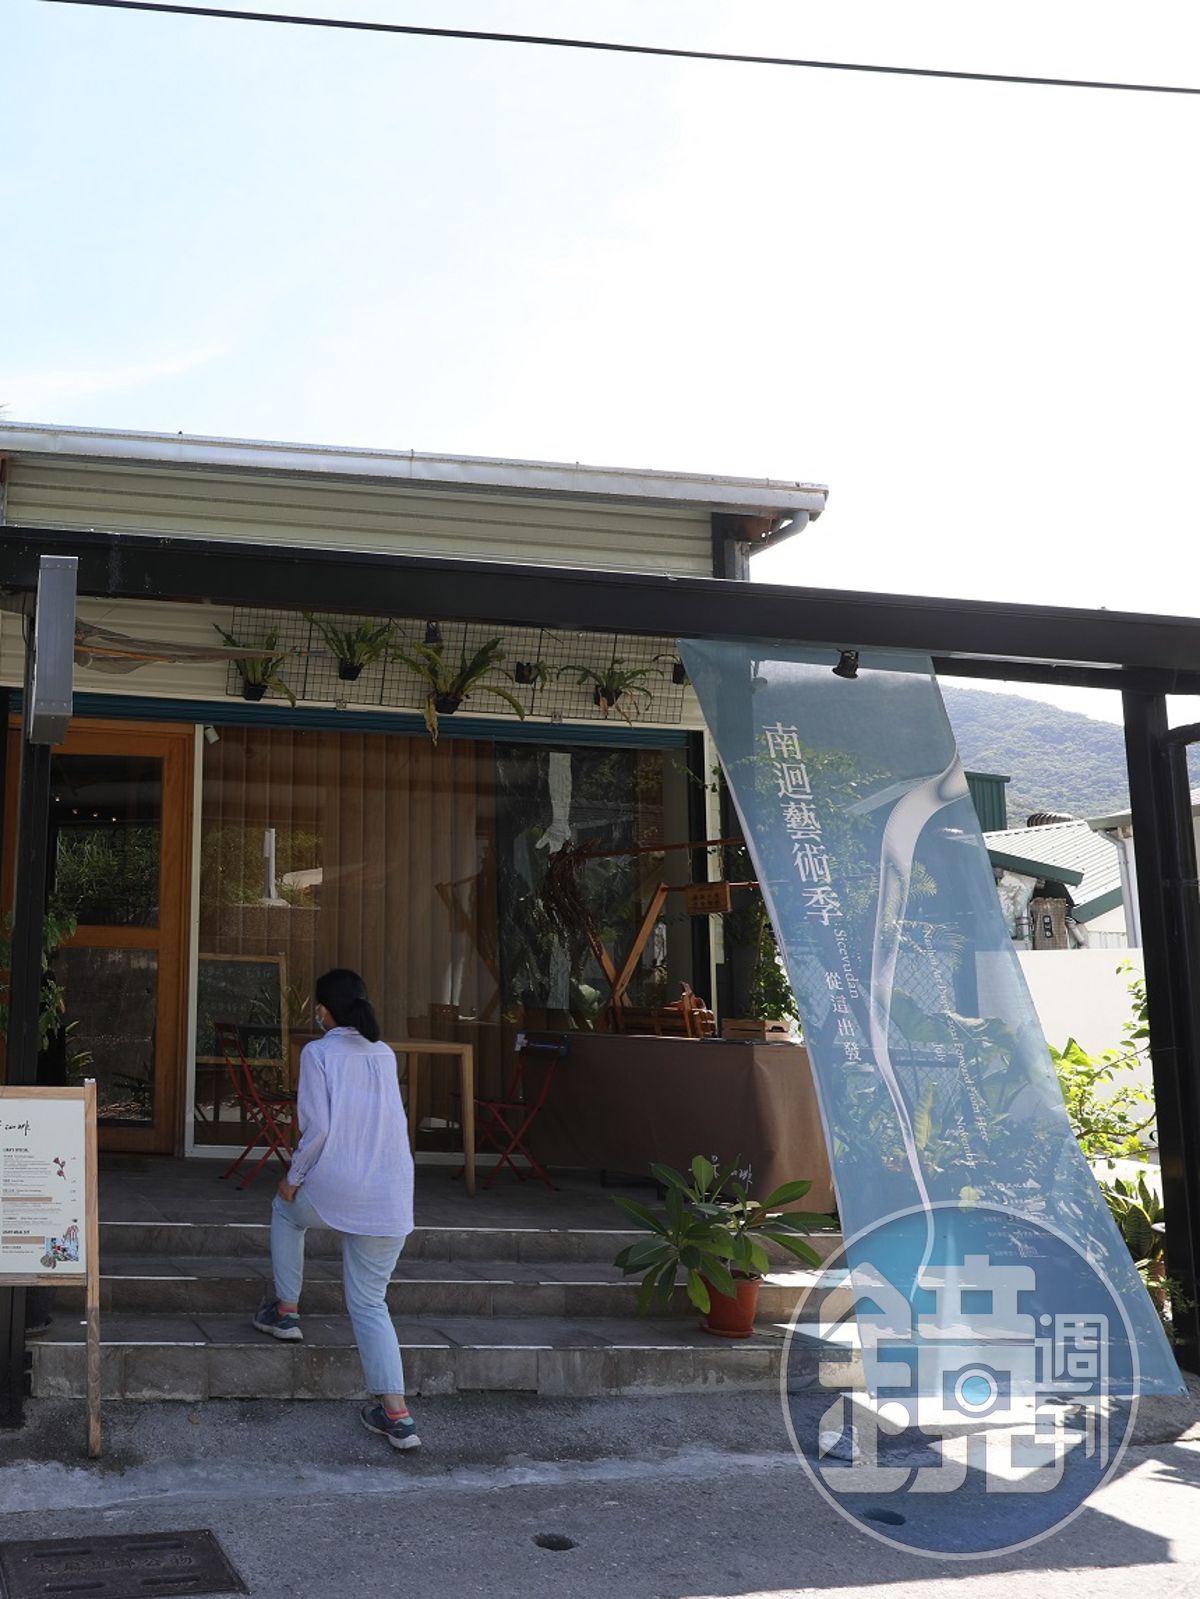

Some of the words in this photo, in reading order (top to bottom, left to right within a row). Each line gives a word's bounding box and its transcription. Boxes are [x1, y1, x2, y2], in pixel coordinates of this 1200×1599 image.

[762, 721, 844, 926] 南迴藝術季
[834, 928, 860, 1000] Sicevudan
[824, 971, 861, 1061] 從這出發
